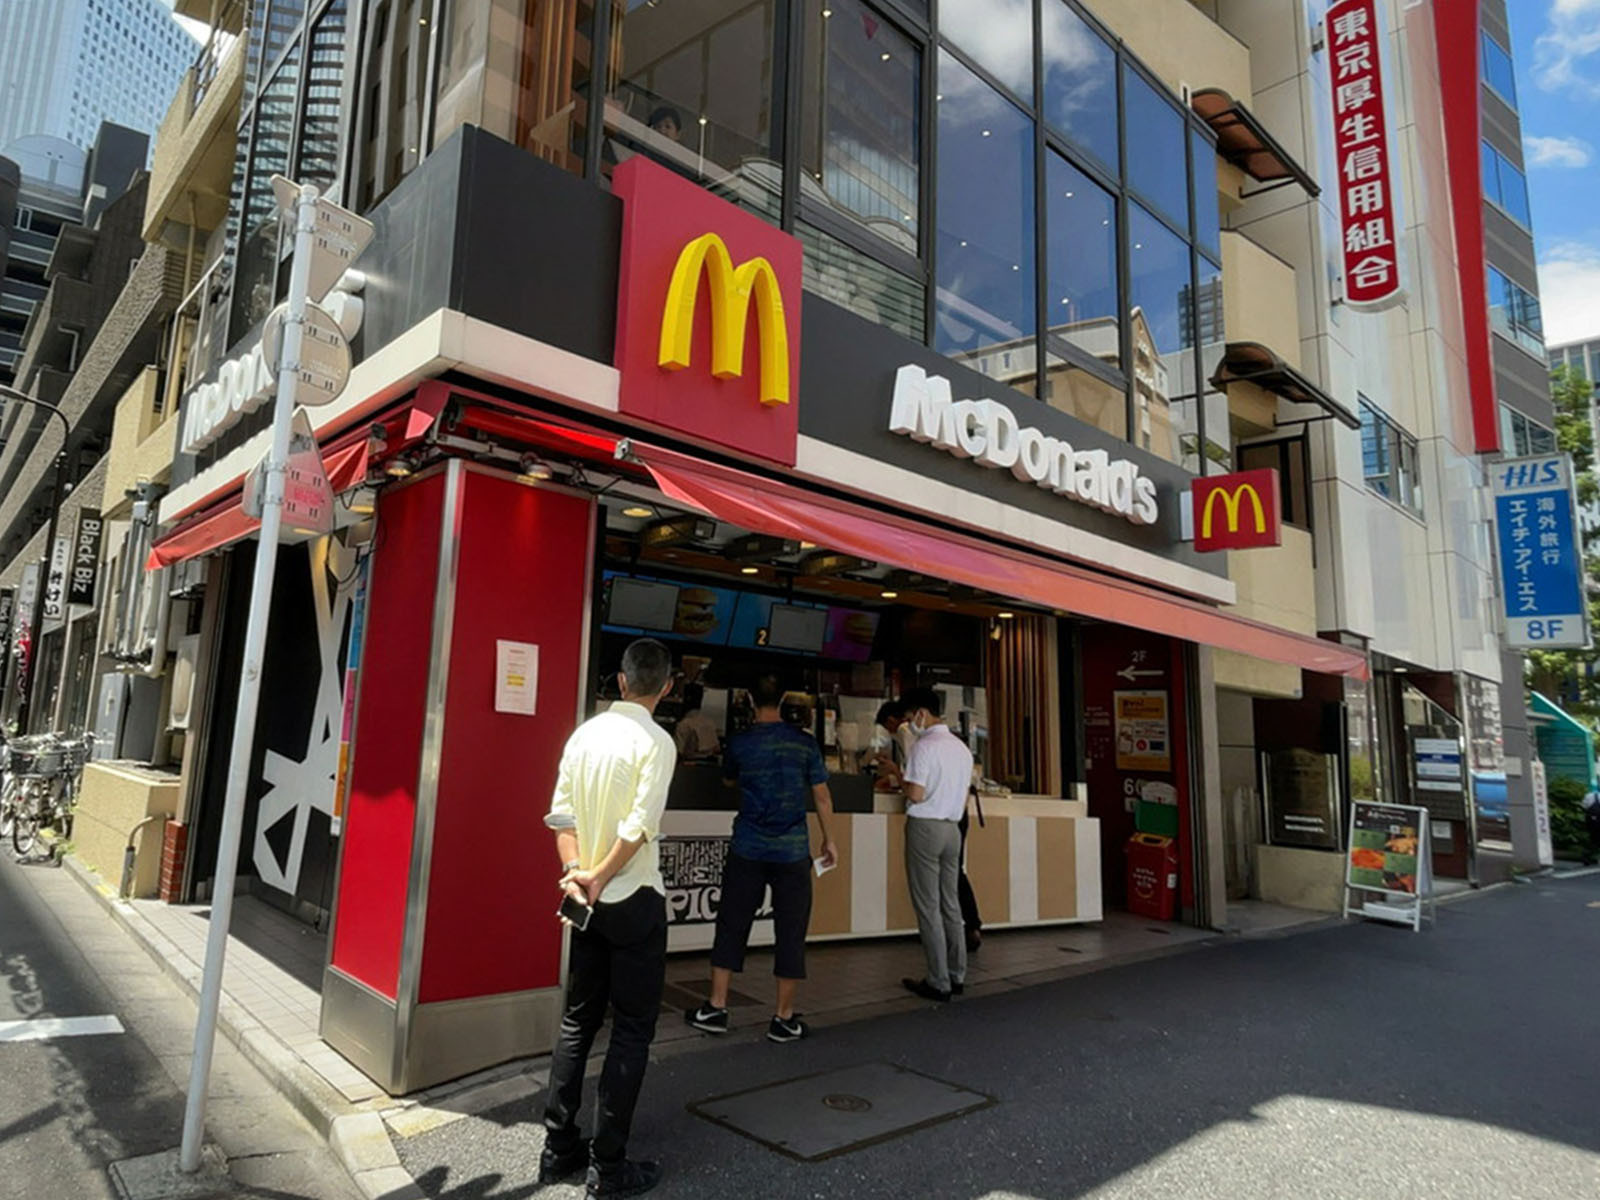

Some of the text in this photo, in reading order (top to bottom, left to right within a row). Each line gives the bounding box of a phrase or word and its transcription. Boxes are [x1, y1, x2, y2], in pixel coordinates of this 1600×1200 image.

[1333, 7, 1393, 290] 東京厚生信用組合
[888, 363, 1158, 525] McDonald's
[1500, 460, 1560, 488] HIS
[1536, 497, 1561, 566] 海外旅行
[72, 518, 101, 594] Black Biz
[757, 629, 767, 646] 2
[1527, 619, 1563, 640] 8F
[1131, 650, 1148, 663] 2F
